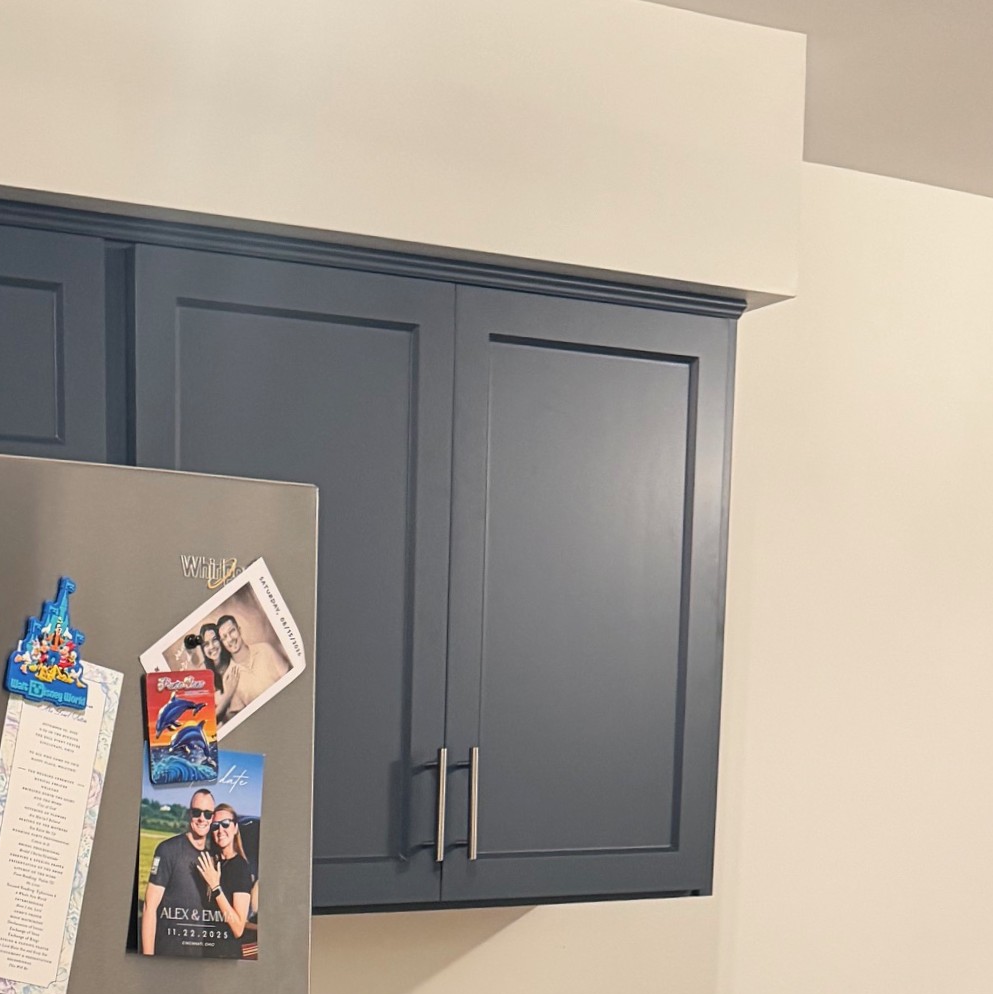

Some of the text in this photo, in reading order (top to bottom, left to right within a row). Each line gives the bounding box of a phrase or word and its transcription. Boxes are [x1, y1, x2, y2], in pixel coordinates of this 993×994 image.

[180, 554, 246, 587] Whirlpo
[259, 576, 280, 616] SATURDAY,
[10, 678, 28, 691] Walt
[64, 692, 86, 706] World
[218, 764, 248, 794] date
[160, 906, 189, 920] ALEX
[191, 908, 200, 921] &
[168, 928, 228, 939] 11.22.2025
